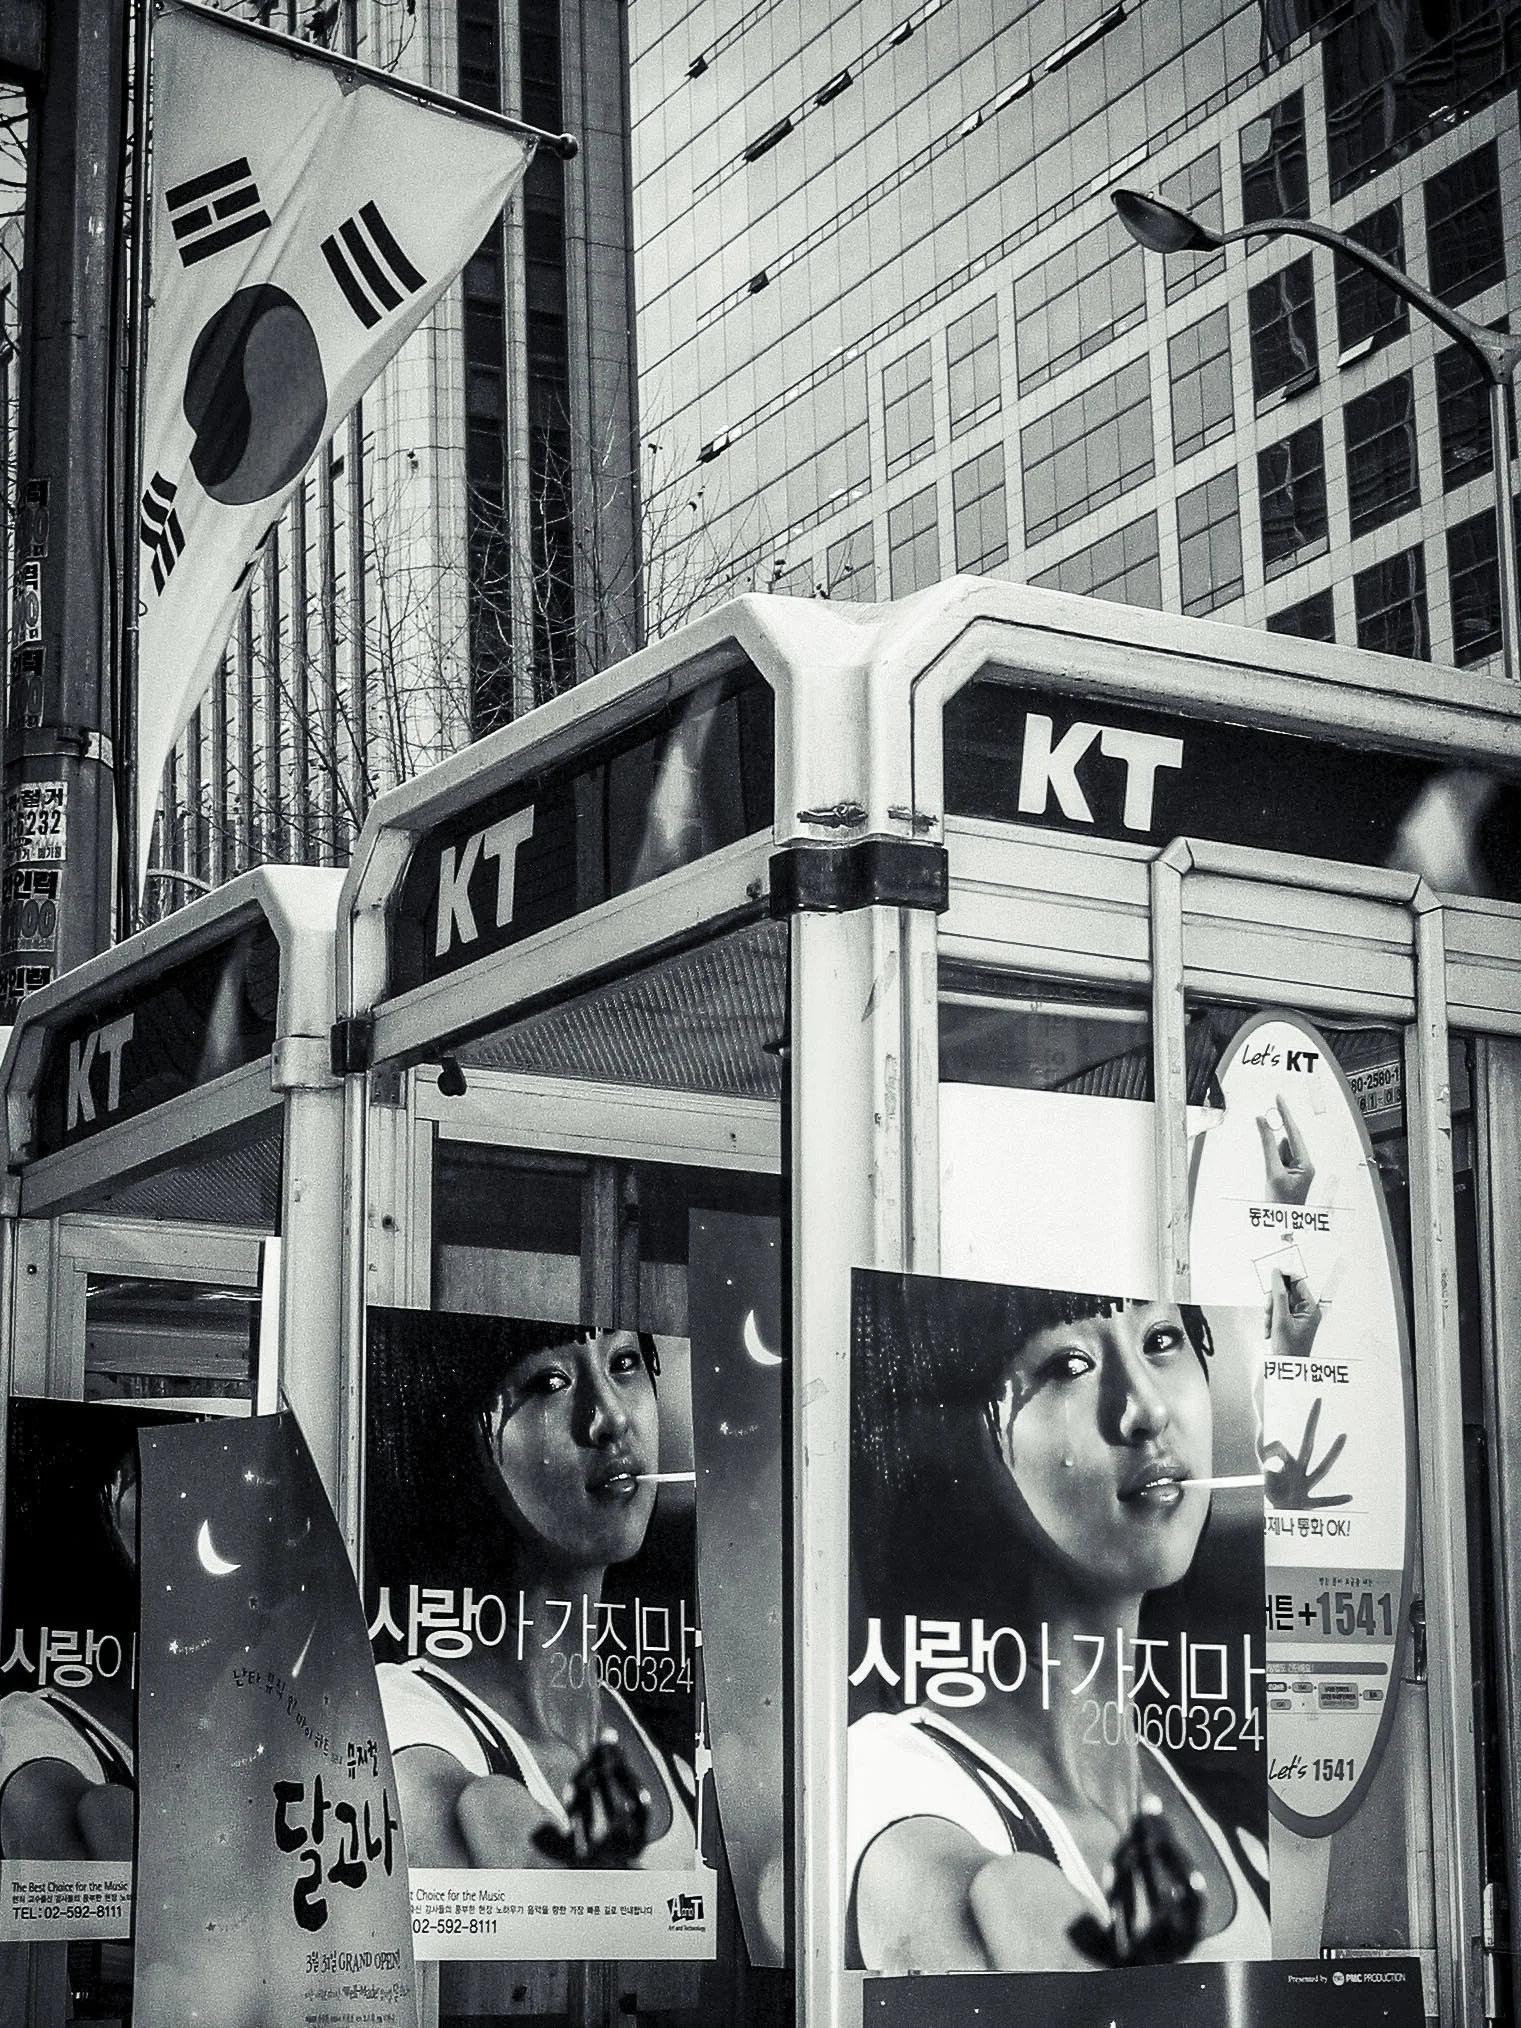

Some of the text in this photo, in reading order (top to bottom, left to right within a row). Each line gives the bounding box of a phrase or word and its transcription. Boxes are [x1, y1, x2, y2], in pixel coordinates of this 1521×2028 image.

[1018, 712, 1184, 832] KT
[434, 804, 535, 957] KT
[1242, 1044, 1319, 1073] Let's KT
[66, 1013, 135, 1131] KT
[1249, 1208, 1330, 1231] 동전이 없어도
[1264, 1361, 1349, 1383] 카드가 없어도
[1264, 1516, 1351, 1537] 제나 통화 OK!
[551, 1652, 695, 1694] 20060324
[1082, 1699, 1265, 1752] 20060324
[346, 1739, 379, 1780] 뮤지컬
[1269, 1754, 1355, 1782] Let's 1541
[12, 1881, 128, 1892] The Best Choice for the Music
[416, 1888, 445, 1901] Choice
[447, 1888, 460, 1901] for
[462, 1890, 476, 1901] the
[479, 1889, 506, 1901] Music
[412, 1918, 497, 1934] 02-592-8111
[338, 1951, 372, 1973] GRAND
[1364, 1972, 1407, 1983] PRODUCTION
